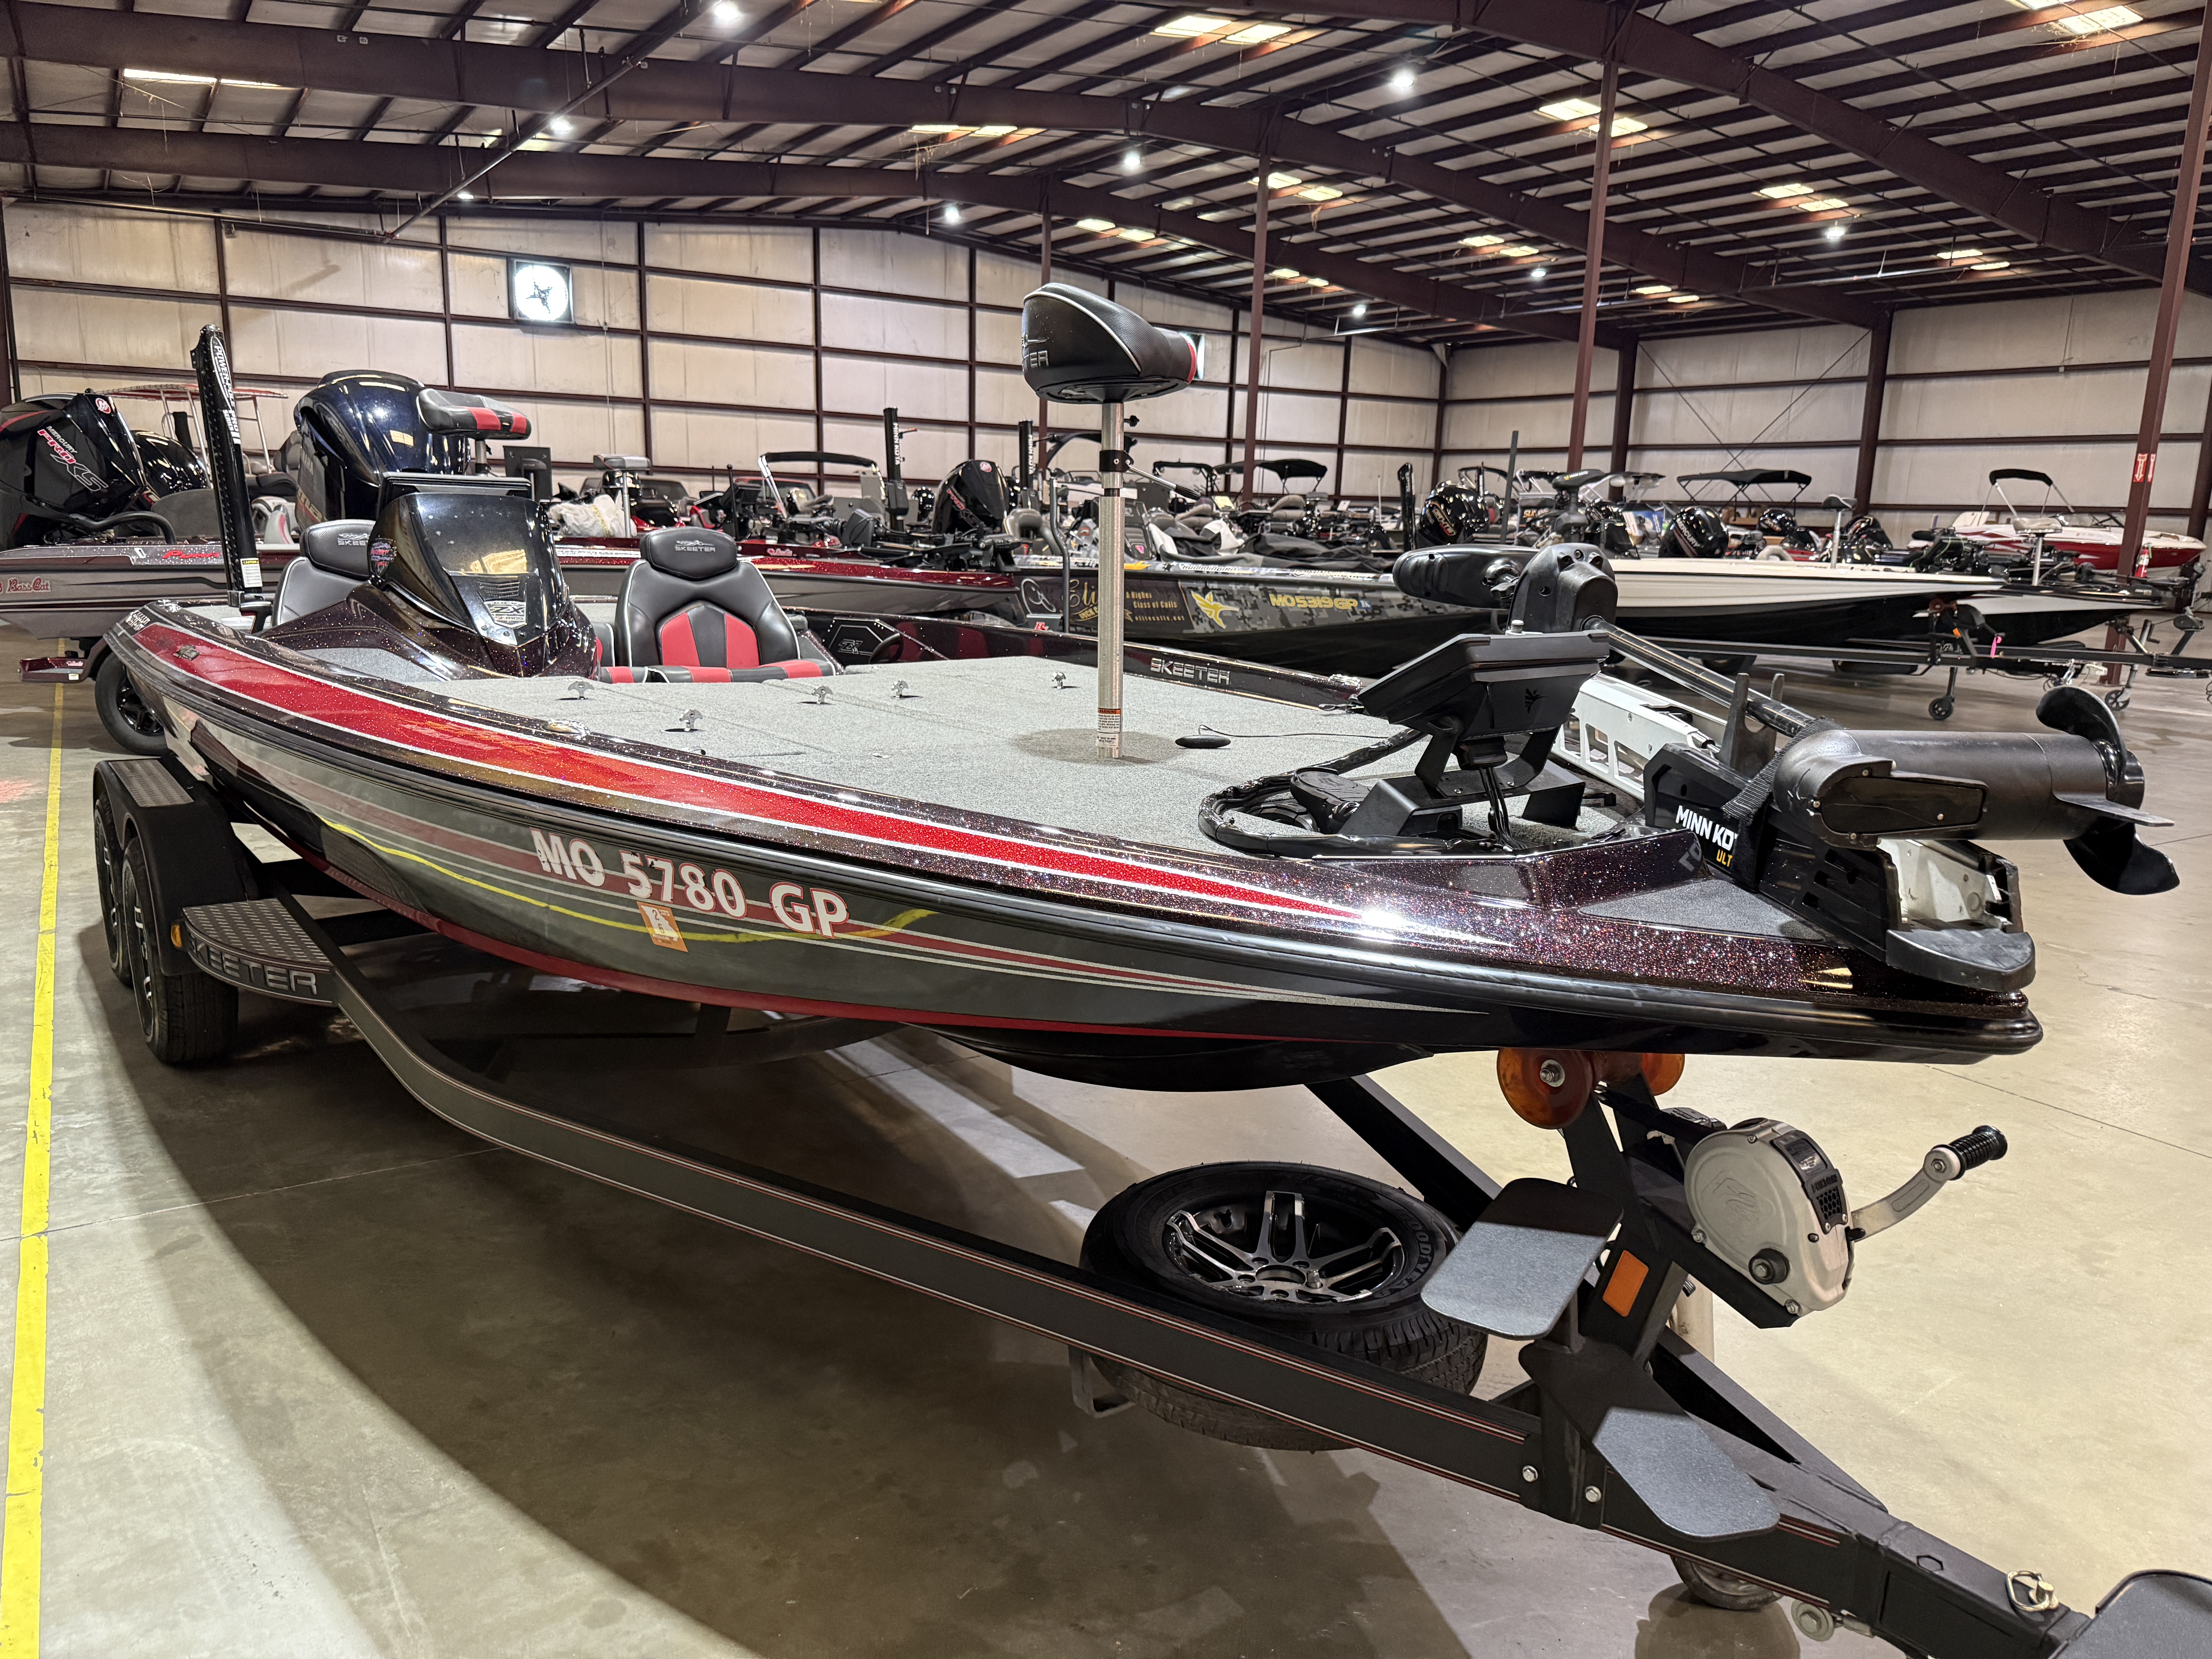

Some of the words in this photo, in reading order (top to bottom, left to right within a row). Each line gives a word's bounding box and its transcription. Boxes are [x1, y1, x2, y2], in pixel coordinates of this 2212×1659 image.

[214, 345, 235, 407] POWER-POLE
[228, 410, 240, 431] PRO
[37, 429, 76, 464] PRO
[46, 426, 77, 453] MERCURY
[50, 454, 109, 492] XS
[1061, 579, 1098, 607] Eli
[1151, 658, 1230, 685] SKEETER
[1676, 805, 1713, 840] MINN
[1712, 824, 1738, 851] KO
[1716, 849, 1733, 867] ULT
[530, 828, 605, 886] MO
[620, 850, 747, 919] 5780
[769, 881, 849, 939] GP
[653, 909, 659, 921] 2
[658, 923, 665, 934] 6
[189, 932, 317, 995] SKEETER
